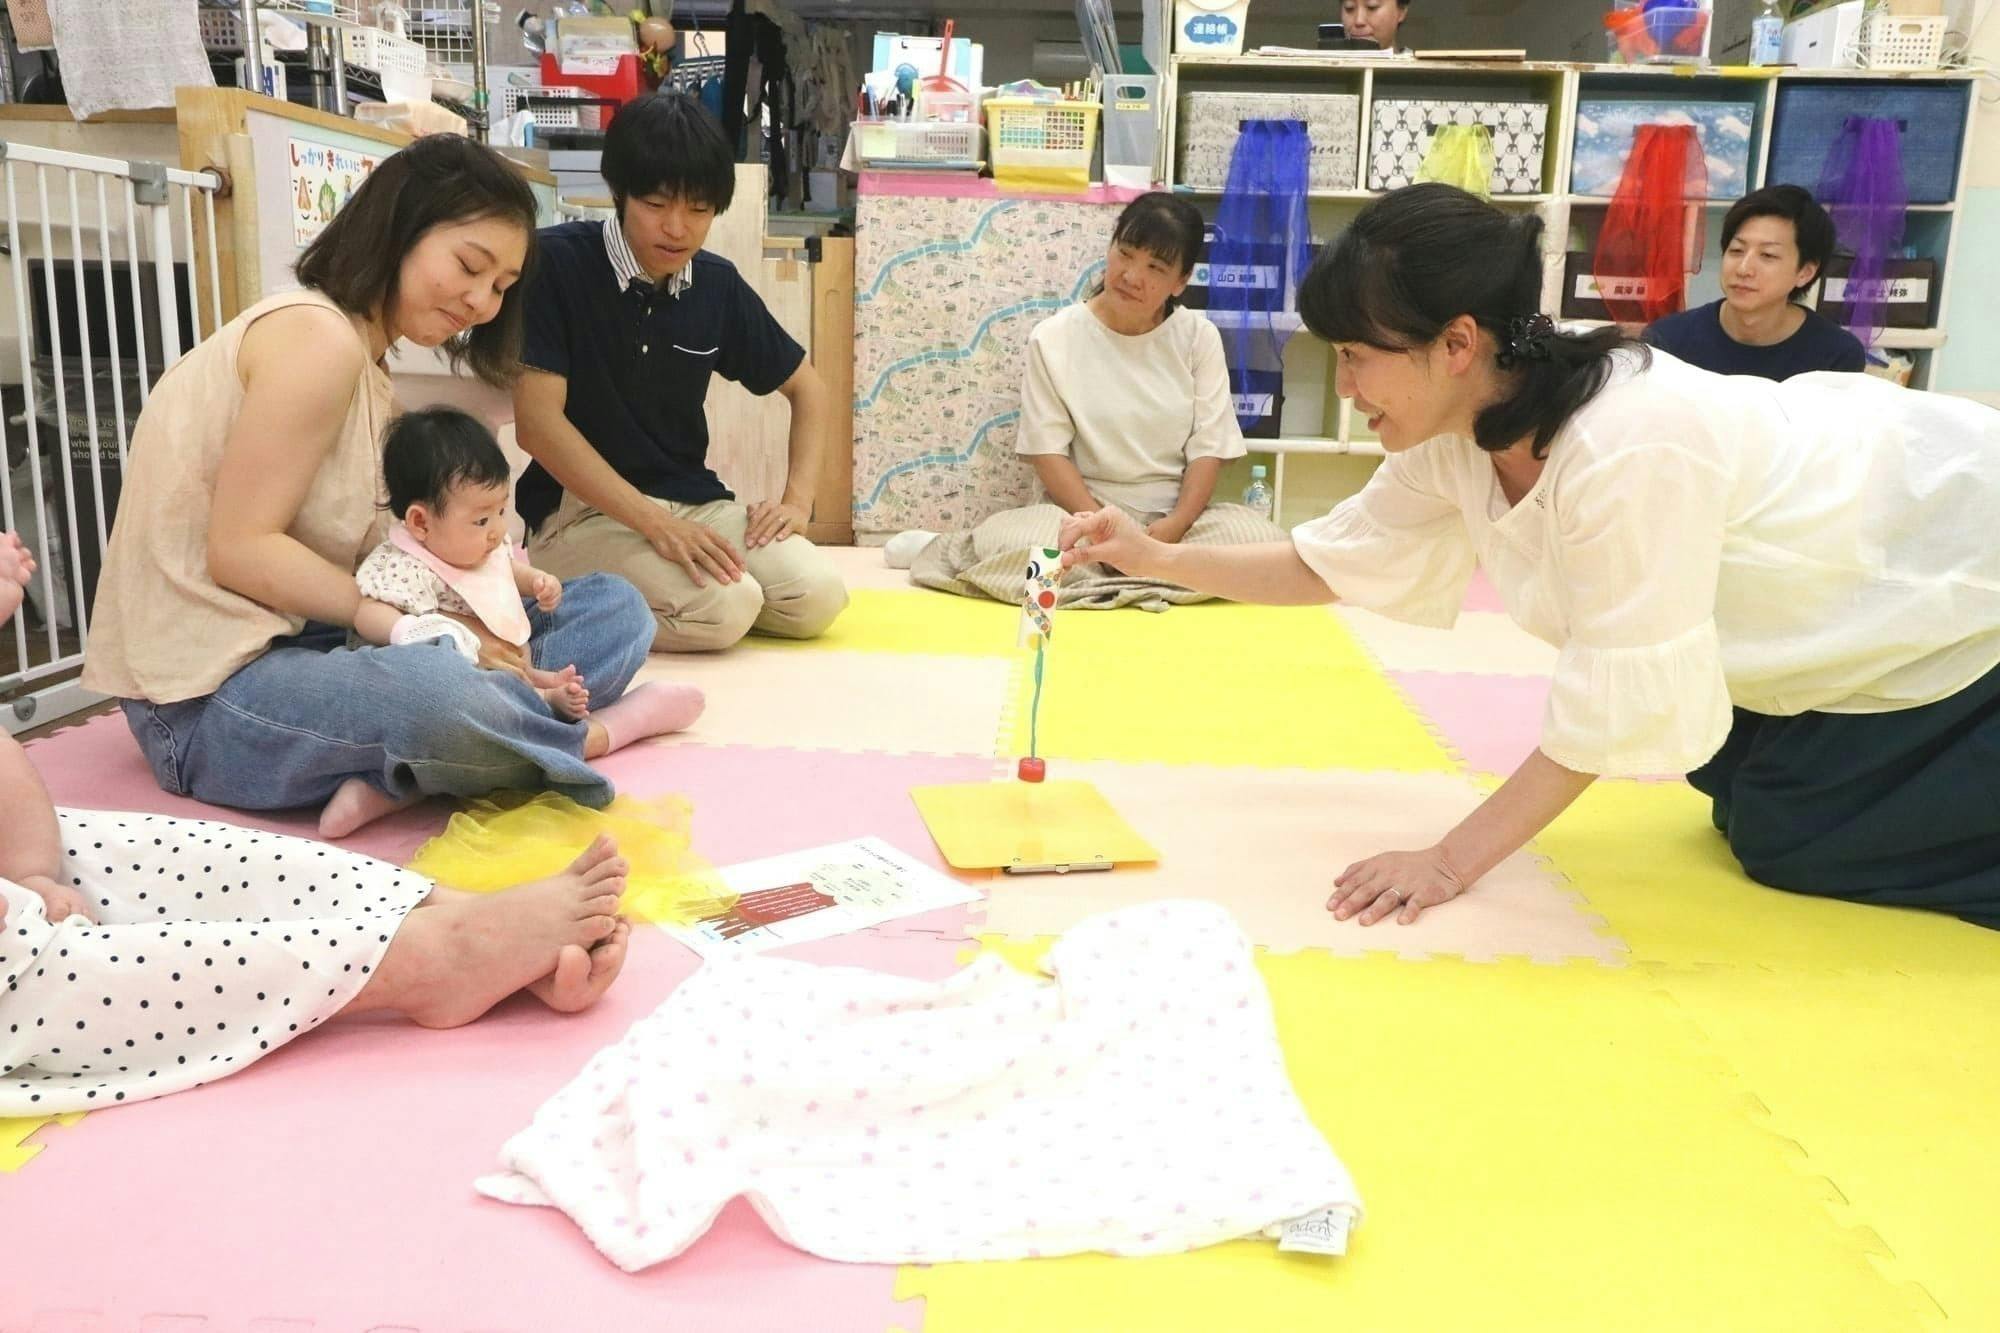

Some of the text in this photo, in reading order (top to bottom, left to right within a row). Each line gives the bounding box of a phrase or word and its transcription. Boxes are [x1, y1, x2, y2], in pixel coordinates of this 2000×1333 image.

[1193, 23, 1228, 35] 連絡帳
[72, 450, 106, 459] shod
